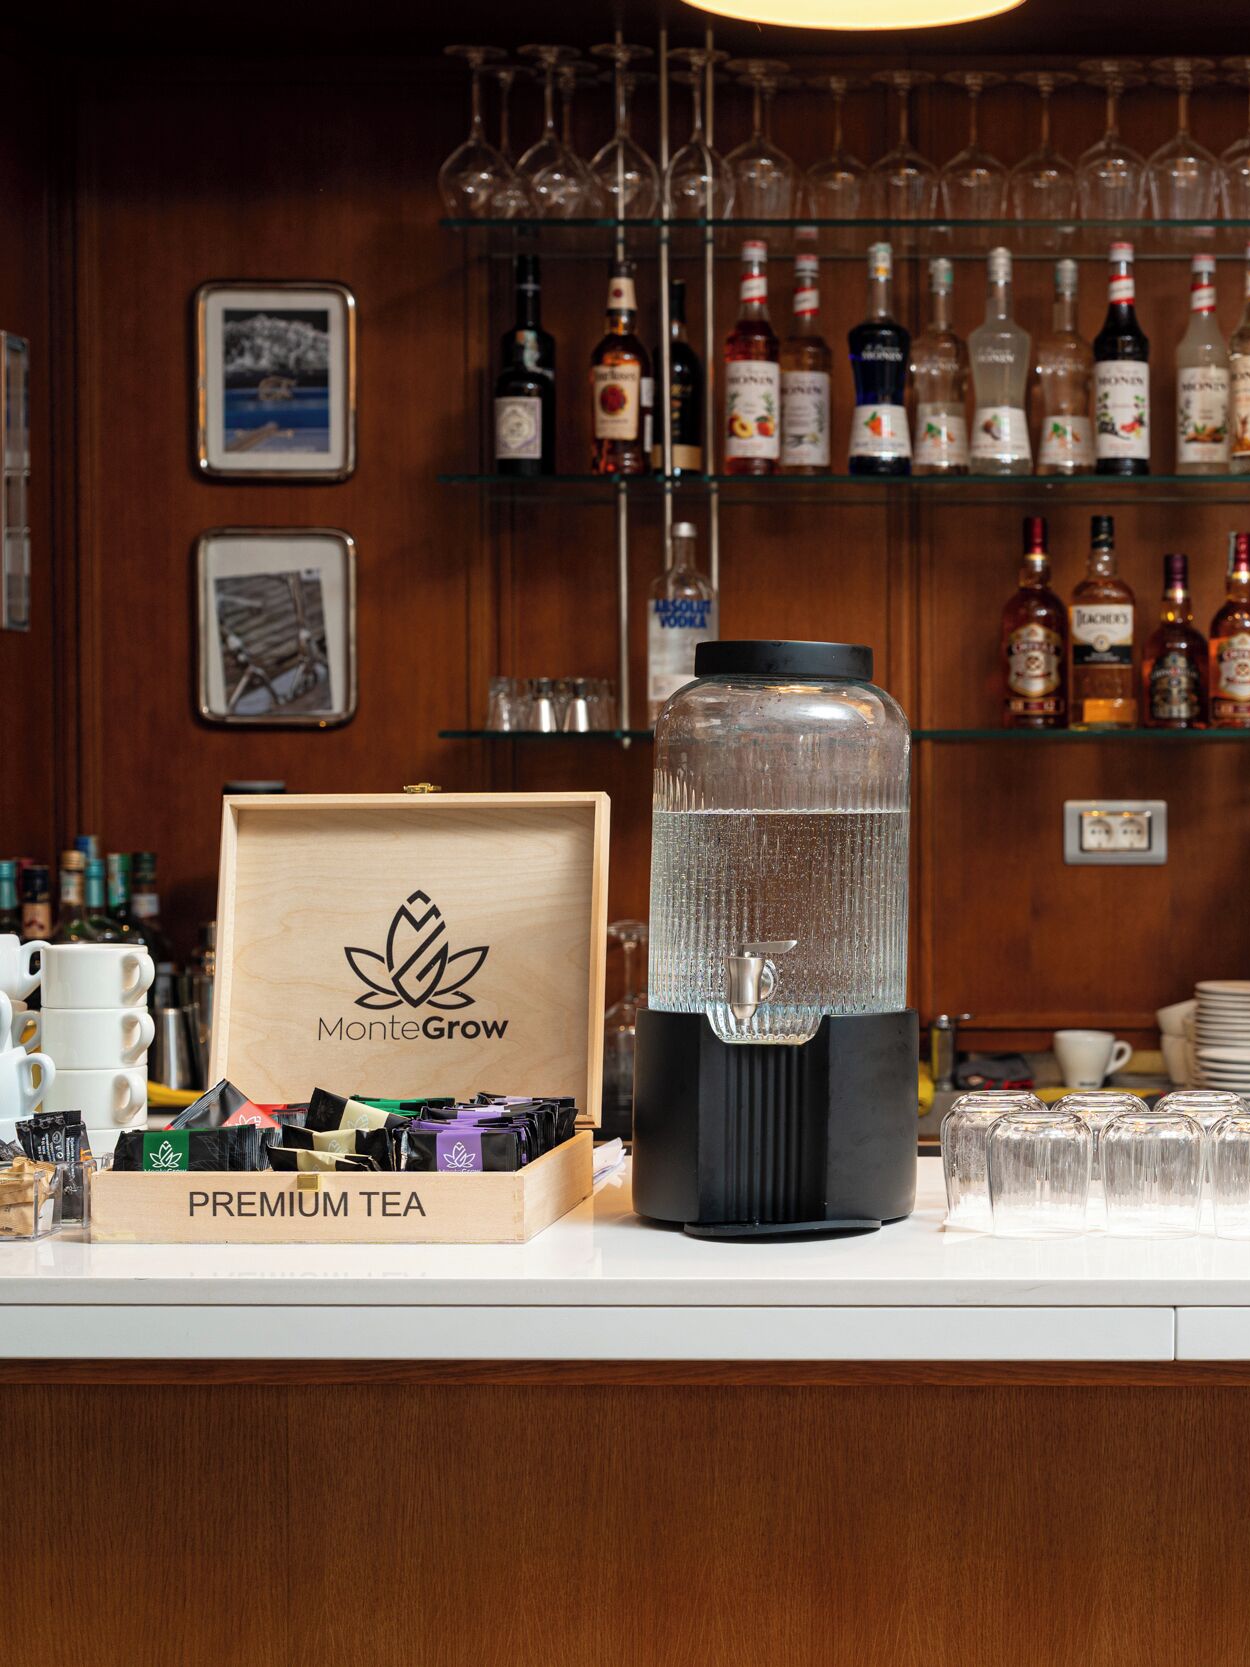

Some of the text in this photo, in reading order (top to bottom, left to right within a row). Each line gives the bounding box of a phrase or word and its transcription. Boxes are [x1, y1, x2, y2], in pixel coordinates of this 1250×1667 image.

[654, 599, 712, 614] ABSOLUT
[659, 615, 708, 629] VODKA
[318, 1015, 509, 1041] MonteGrow
[189, 1191, 427, 1217] PREMIUM TEA
